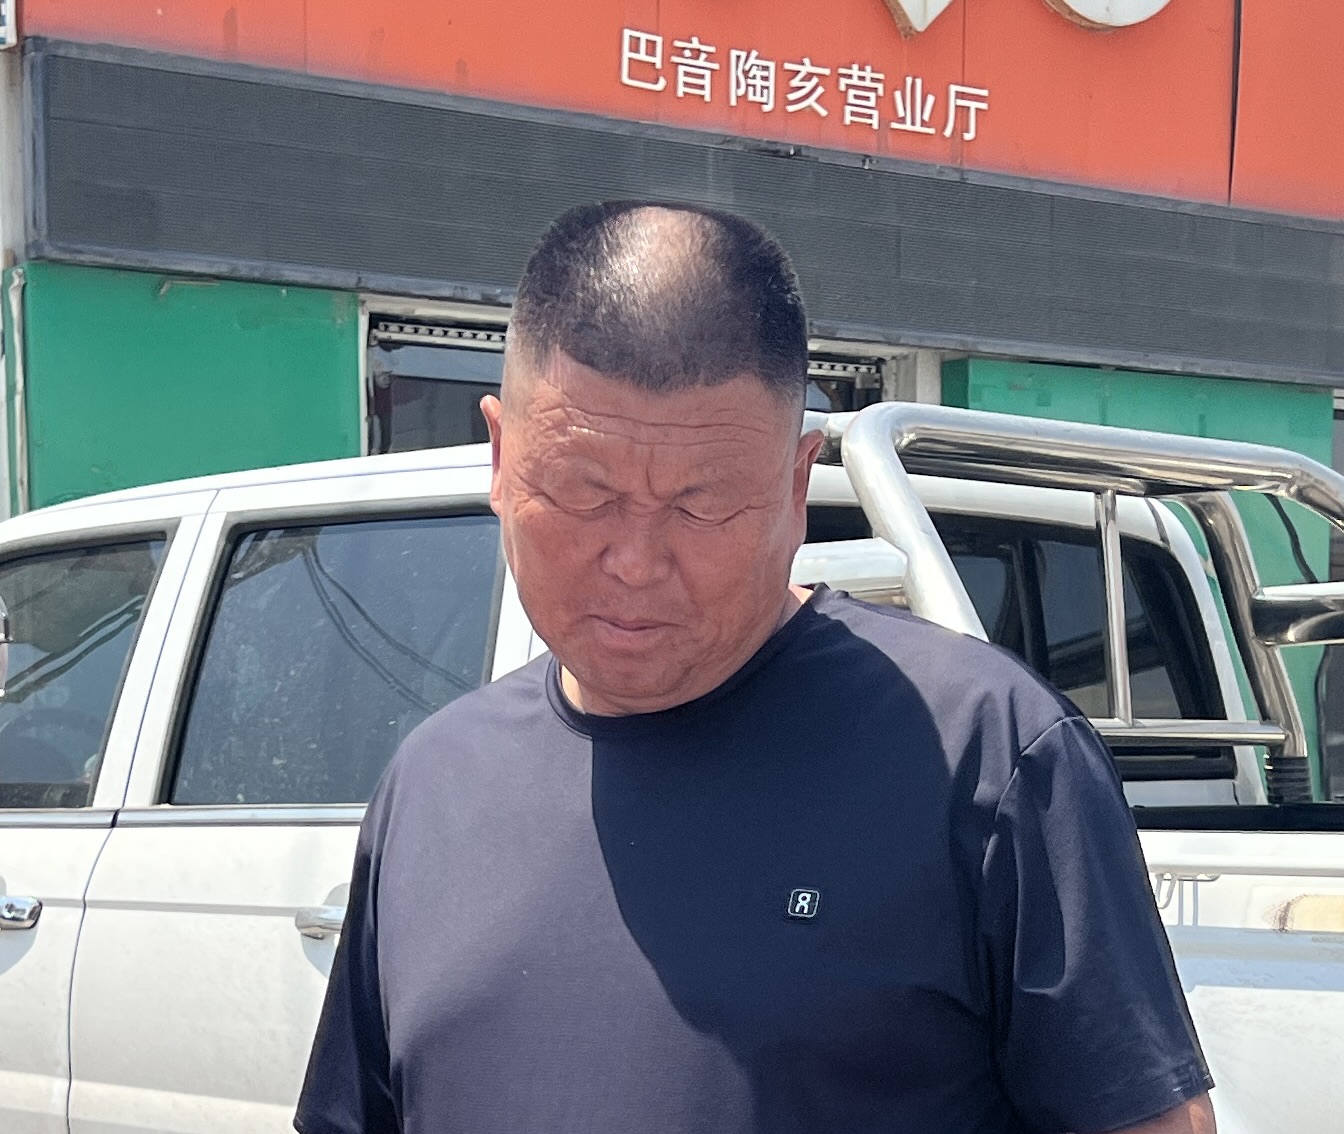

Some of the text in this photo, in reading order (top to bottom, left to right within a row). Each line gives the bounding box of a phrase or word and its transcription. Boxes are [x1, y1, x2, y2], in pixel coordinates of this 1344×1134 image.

[620, 28, 989, 141] 巴音陶亥营业厅
